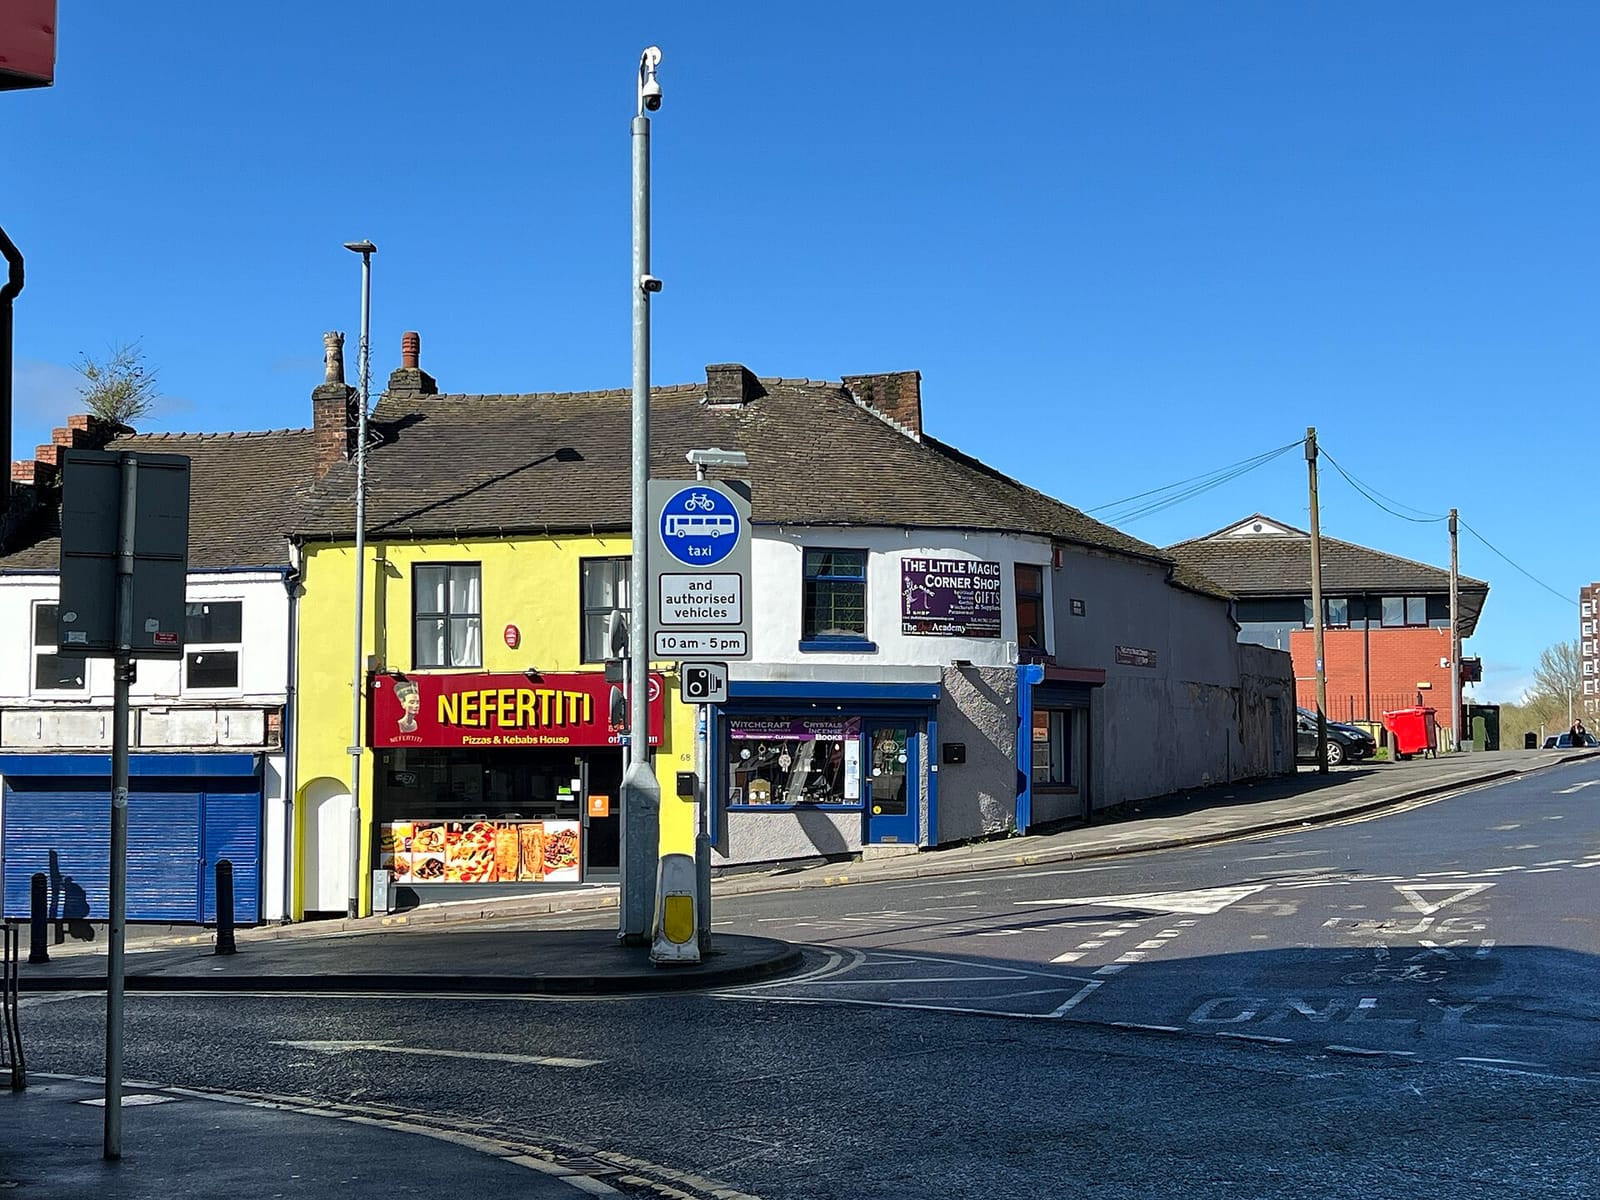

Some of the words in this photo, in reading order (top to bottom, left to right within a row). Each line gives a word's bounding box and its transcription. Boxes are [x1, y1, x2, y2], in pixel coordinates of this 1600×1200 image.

[688, 545, 712, 556] taxi
[902, 558, 926, 572] THE
[929, 560, 966, 574] LITTLE
[968, 562, 1000, 576] MAGIC
[688, 580, 712, 590] and
[925, 574, 971, 588] CORNER
[973, 576, 1000, 590] SHOP
[666, 594, 736, 604] authorised
[974, 590, 1000, 604] GIFTS
[674, 608, 728, 618] vehicles
[902, 622, 917, 631] The
[932, 622, 966, 634] Academy
[661, 638, 676, 648] 10
[680, 640, 698, 648] am
[710, 638, 718, 648] 5
[720, 640, 740, 650] pm
[438, 688, 591, 727] NEFERTITI
[462, 736, 492, 744] Pizzas
[492, 736, 500, 744] &
[502, 736, 538, 744] Kebabs
[540, 736, 570, 744] House
